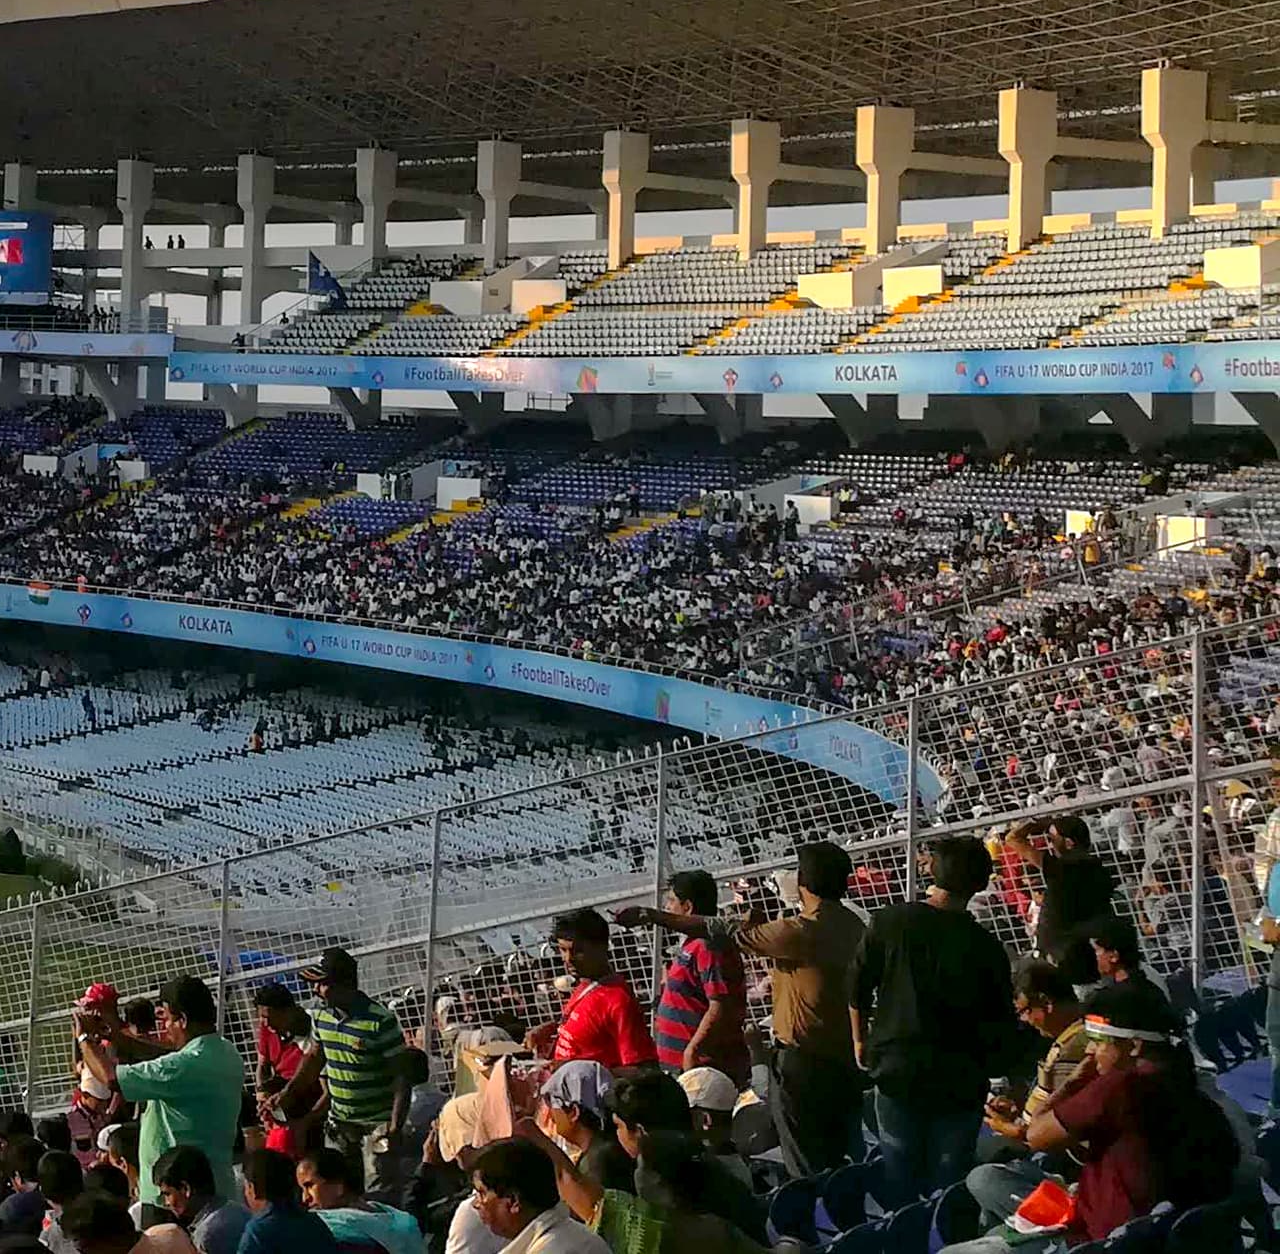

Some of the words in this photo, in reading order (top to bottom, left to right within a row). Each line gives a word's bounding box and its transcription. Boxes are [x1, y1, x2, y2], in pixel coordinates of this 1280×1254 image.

[835, 365, 898, 381] KOLKATA
[994, 364, 1015, 378] FIFA
[1041, 363, 1076, 378] WORLD
[1078, 363, 1099, 376] CUP
[1100, 362, 1128, 376] INDIA
[1130, 361, 1154, 376] 2017
[179, 614, 234, 635] KOLKATA
[363, 641, 394, 656] WORLD
[395, 645, 413, 658] CUP
[511, 662, 612, 696] #FootballTakesOver
